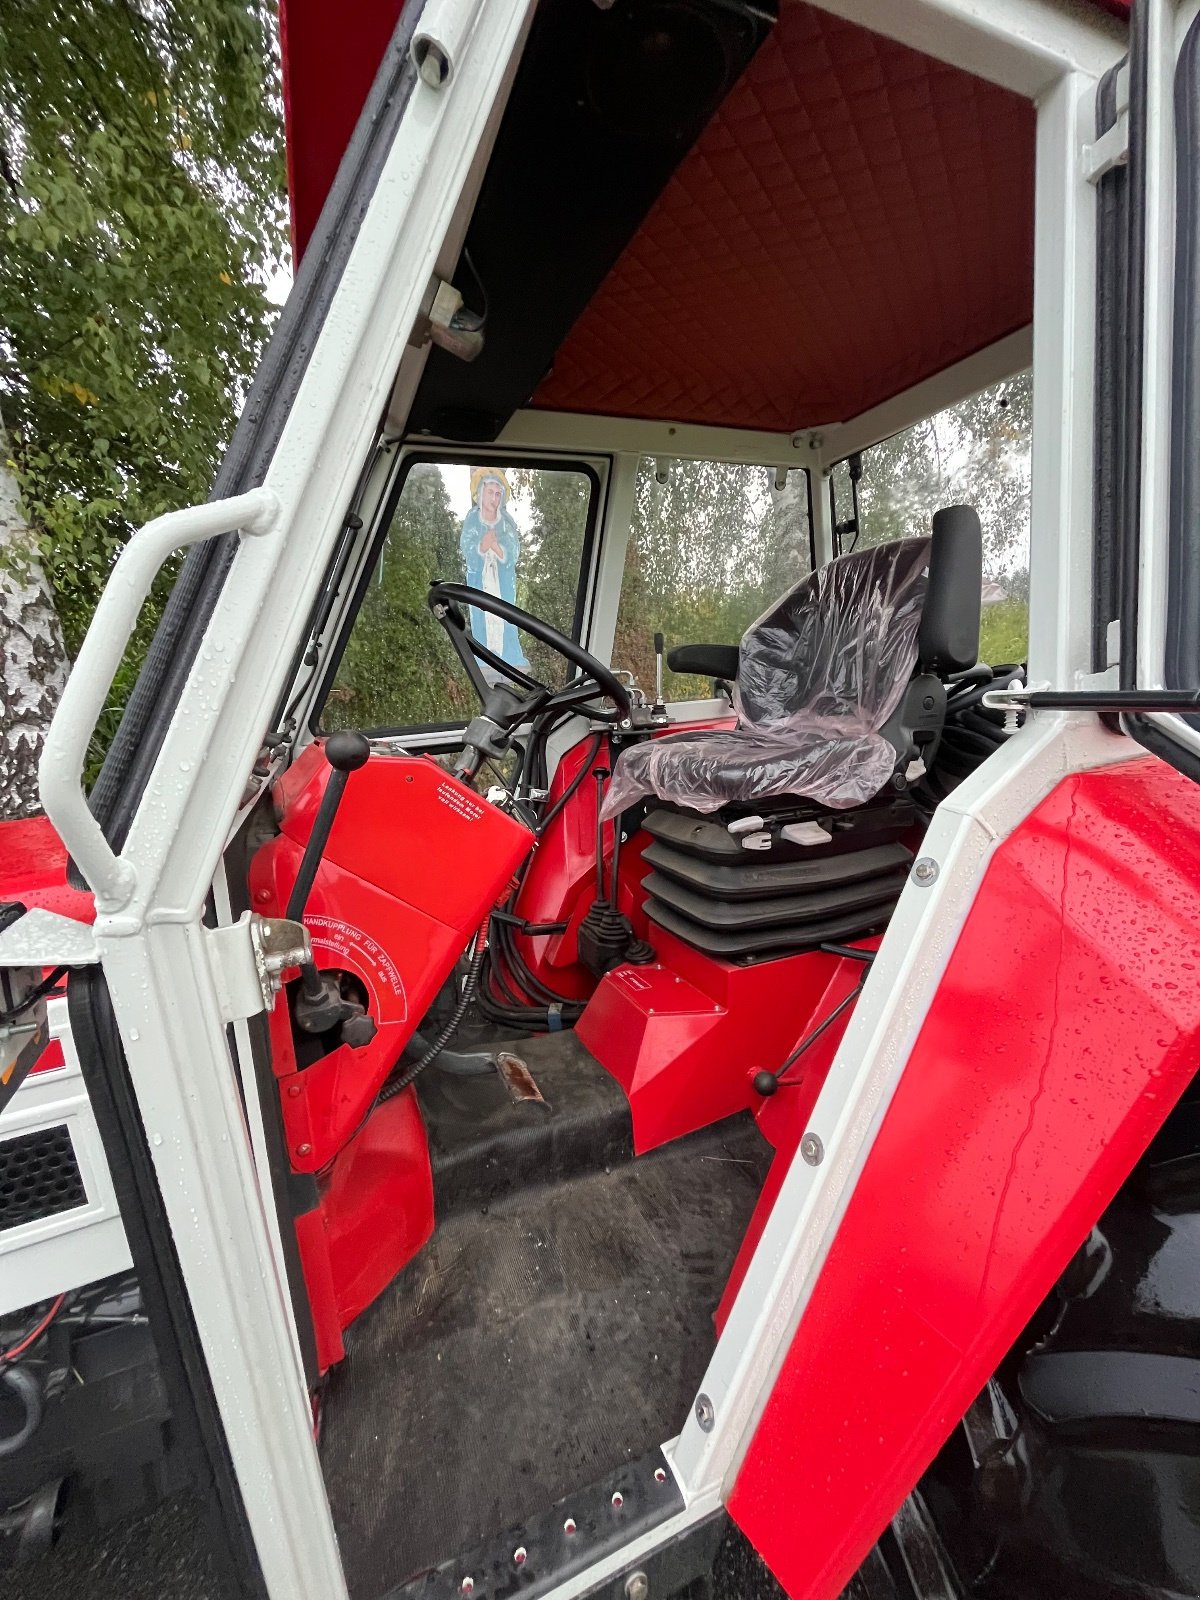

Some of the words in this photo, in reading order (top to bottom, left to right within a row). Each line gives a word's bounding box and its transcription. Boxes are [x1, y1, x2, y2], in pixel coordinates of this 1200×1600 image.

[437, 787, 464, 808] laufendem
[442, 782, 465, 801] Lenkung
[465, 800, 475, 808] nur
[334, 933, 344, 942] ein
[304, 918, 361, 941] HANDKUPPLUNG
[364, 939, 378, 955] FÜR
[378, 955, 401, 996] ZAPFWELLE
[378, 971, 387, 983] aus
